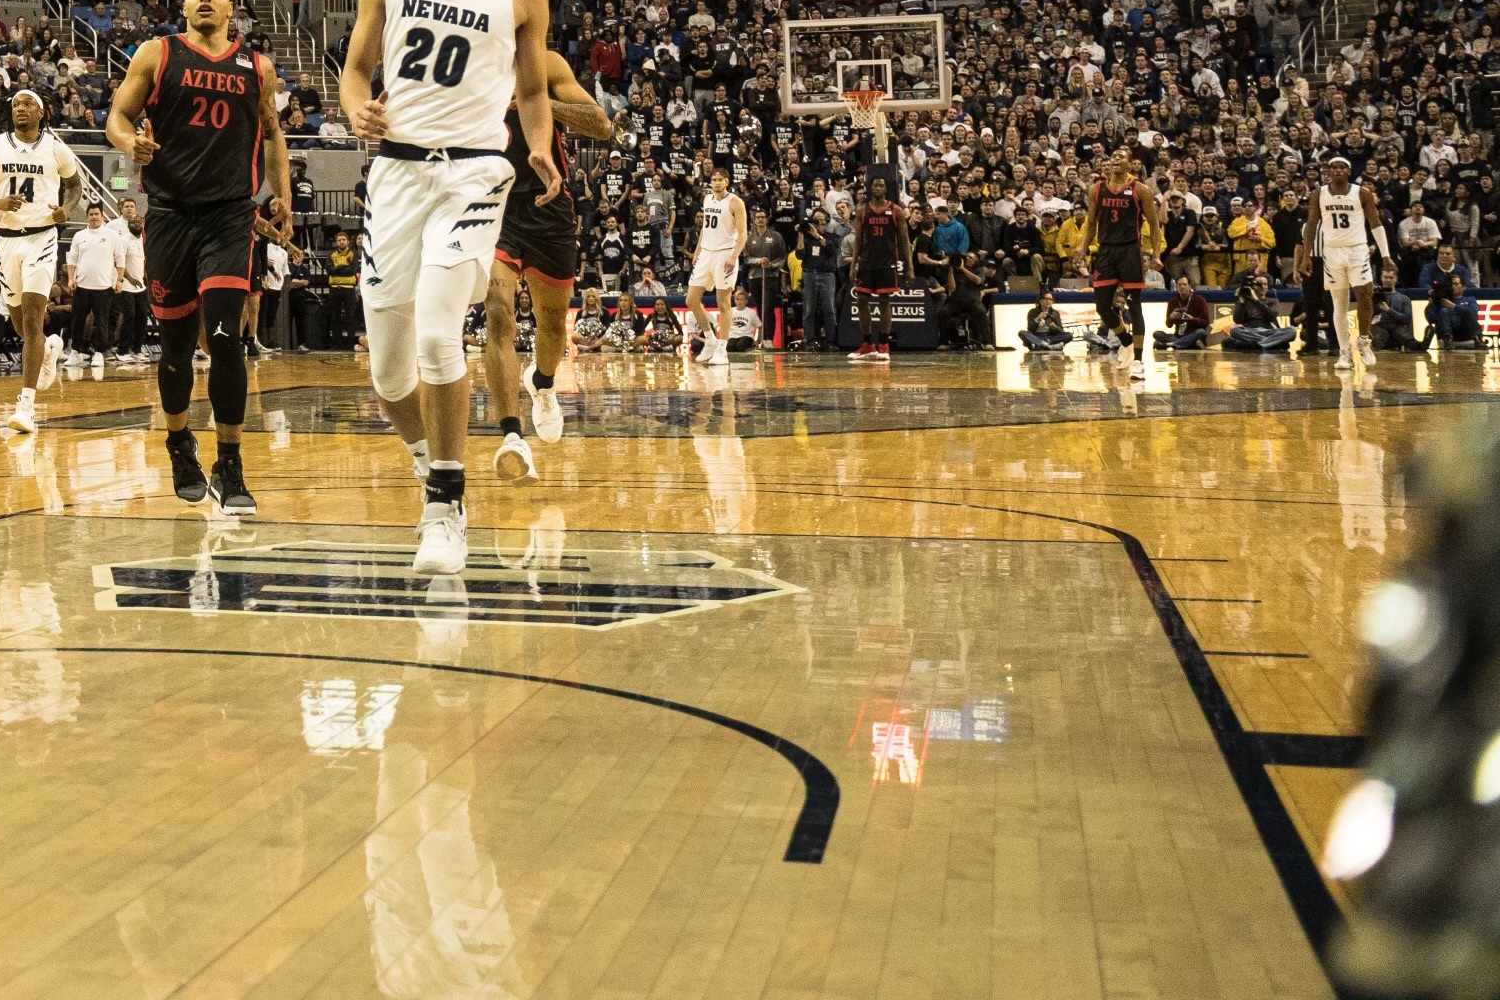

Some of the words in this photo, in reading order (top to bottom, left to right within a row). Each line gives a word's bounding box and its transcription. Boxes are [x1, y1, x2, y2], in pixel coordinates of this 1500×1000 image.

[402, 0, 489, 32] NEVADA
[398, 27, 471, 87] 20
[181, 69, 245, 94] AZTECS
[189, 97, 230, 128] 20
[2, 163, 44, 174] NEVADA
[9, 177, 35, 203] 14
[1102, 198, 1130, 208] AZTECS
[1325, 204, 1354, 212] NEVADA
[1110, 210, 1118, 223] 3
[1331, 213, 1350, 229] 13
[873, 226, 883, 236] 31
[892, 306, 924, 315] LEXUS
